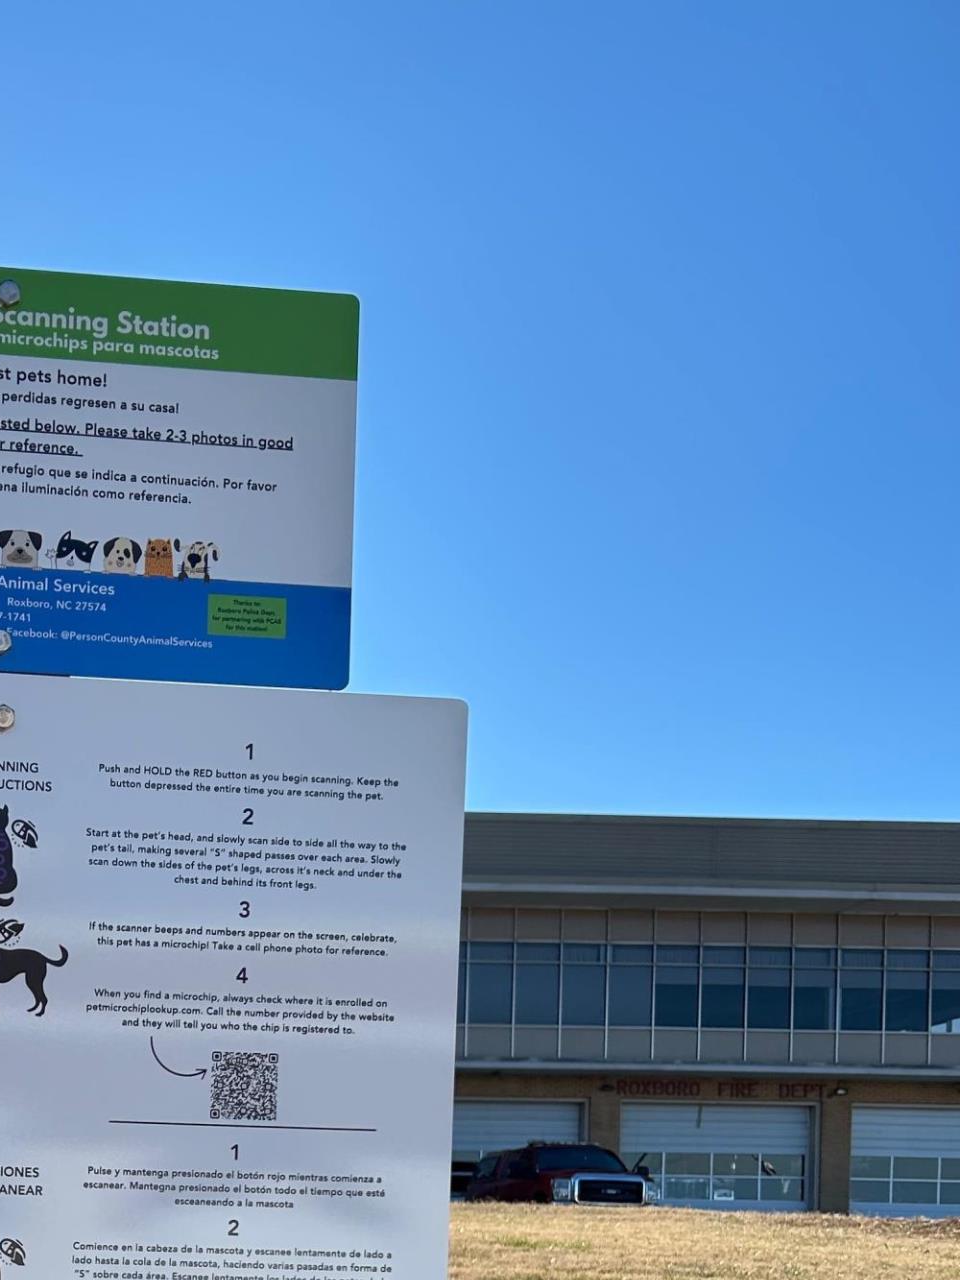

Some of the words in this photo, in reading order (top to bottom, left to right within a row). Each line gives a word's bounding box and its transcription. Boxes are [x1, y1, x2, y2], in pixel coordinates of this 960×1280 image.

[115, 310, 210, 340] Station
[92, 340, 135, 355] para
[138, 343, 219, 360] mascotas
[15, 369, 52, 385] pets
[56, 368, 107, 388] home!
[1, 390, 57, 405] perdidas
[60, 396, 116, 410] regresen
[119, 401, 128, 410] a
[130, 402, 145, 412] su
[148, 402, 179, 414] casa!
[34, 418, 80, 435] below.
[85, 422, 128, 438] Please
[131, 425, 161, 441] take
[165, 428, 187, 443] 2-3
[191, 430, 238, 447] photos
[242, 433, 253, 447] in
[258, 435, 293, 452] good
[9, 437, 78, 455] reference.
[0, 462, 45, 478] refugio
[48, 468, 71, 480] que
[74, 470, 88, 479] se
[91, 468, 127, 482] indica
[129, 473, 137, 483] a
[140, 473, 219, 488] continuación.
[222, 477, 244, 490] Por
[246, 478, 278, 492] favor
[21, 480, 89, 497] iluminación
[91, 489, 125, 500] como
[128, 489, 192, 504] referencia.
[53, 578, 115, 596] Services
[6, 596, 53, 610] Roxboro,
[55, 599, 72, 610] NC
[74, 600, 107, 612] 27574
[60, 630, 213, 649] @PersonCountyAnimalServices
[245, 742, 254, 761] 1
[98, 763, 121, 773] Push
[123, 764, 141, 775] and
[143, 765, 172, 776] HOLD
[174, 767, 190, 777] the
[192, 767, 213, 778] RED
[215, 768, 247, 780] button
[249, 773, 260, 781] as
[261, 773, 280, 783] you
[281, 772, 309, 785] begin
[310, 775, 354, 788] scanning.
[356, 776, 381, 788] Keep
[383, 777, 399, 787] the
[241, 807, 254, 825] 2
[173, 874, 199, 885] chest
[200, 875, 219, 886] and
[220, 876, 254, 887] behind
[255, 878, 267, 888] its
[268, 877, 293, 889] front
[294, 879, 317, 892] legs.
[238, 900, 250, 919] 3
[235, 966, 249, 984] 4
[616, 1079, 701, 1096] ROXBORO
[718, 1081, 759, 1098] FIRE
[778, 1082, 827, 1099] DEPT
[230, 1143, 239, 1161] 1
[227, 1218, 239, 1236] 2
